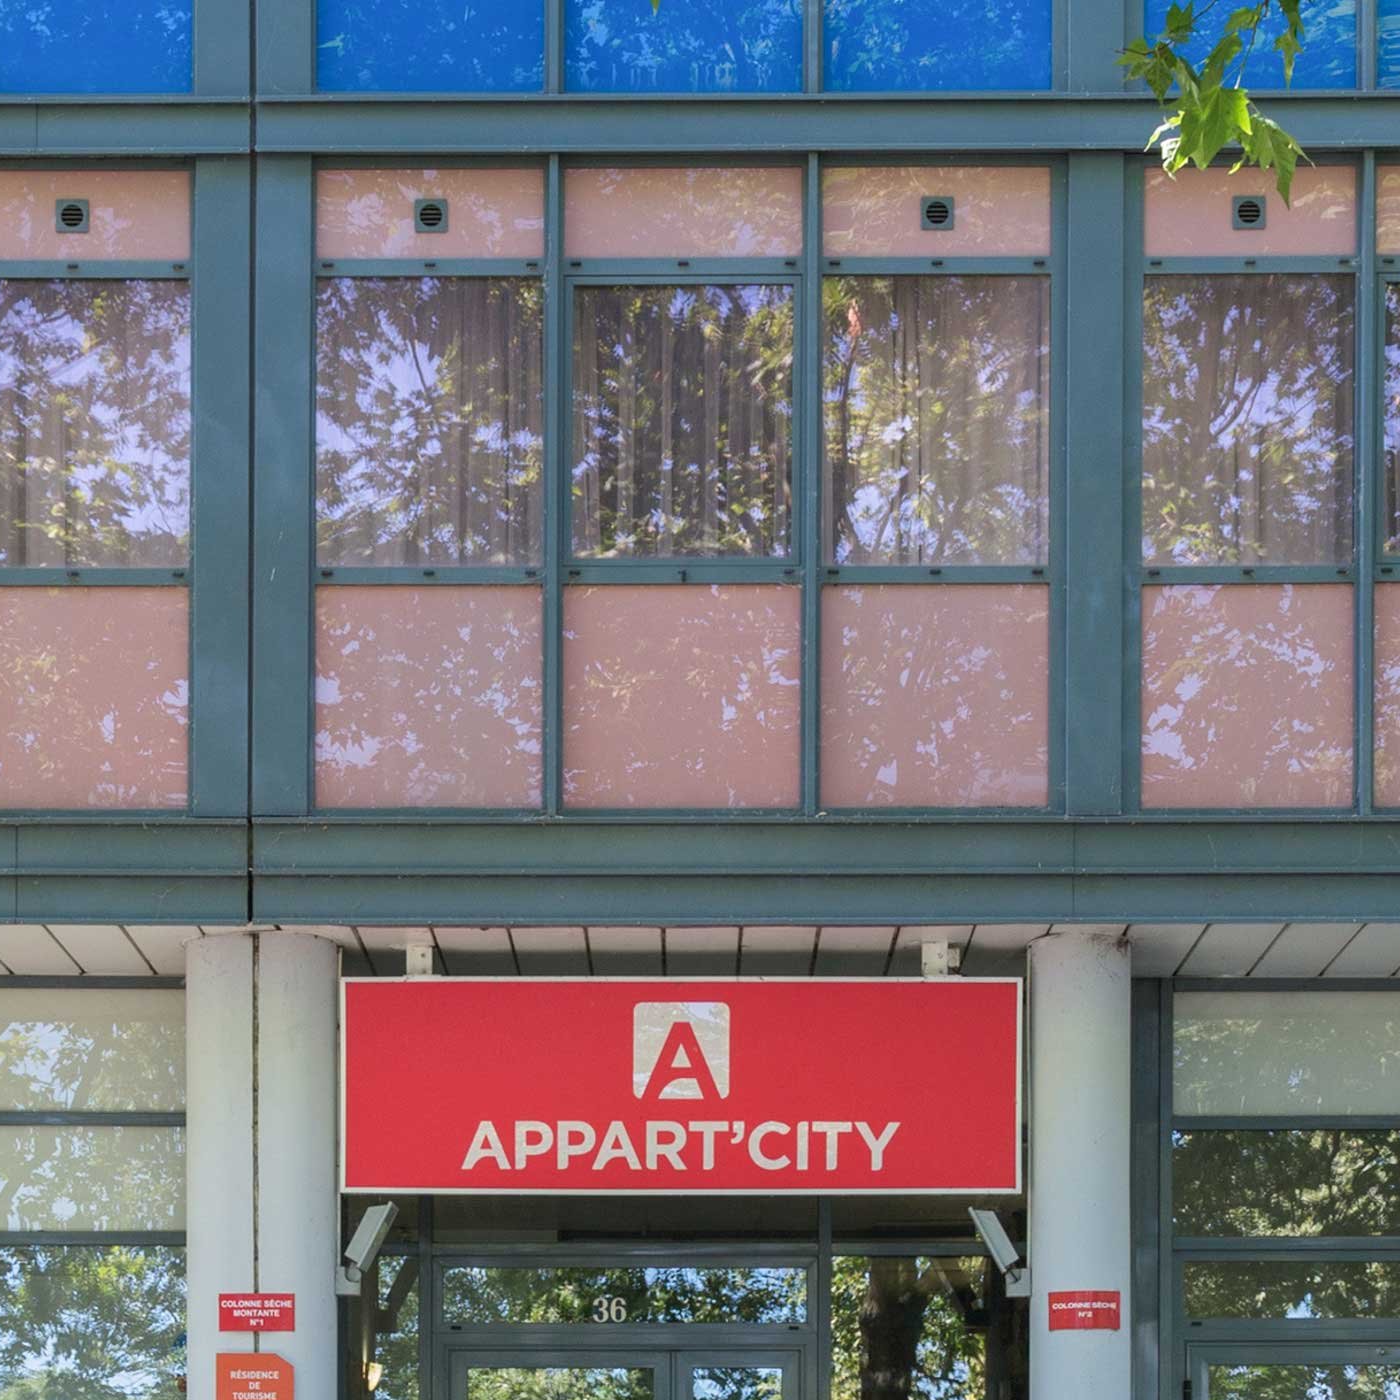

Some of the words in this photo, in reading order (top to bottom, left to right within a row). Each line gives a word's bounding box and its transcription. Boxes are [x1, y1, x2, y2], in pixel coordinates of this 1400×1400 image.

[461, 1120, 901, 1171] APPART'CITY
[221, 1300, 262, 1308] COLONNE
[233, 1309, 280, 1317] MONTANTE
[592, 1297, 627, 1323] 36
[230, 1368, 279, 1380] RÉSIDENCE
[248, 1381, 261, 1390] DE
[232, 1391, 277, 1400] TOURISME
